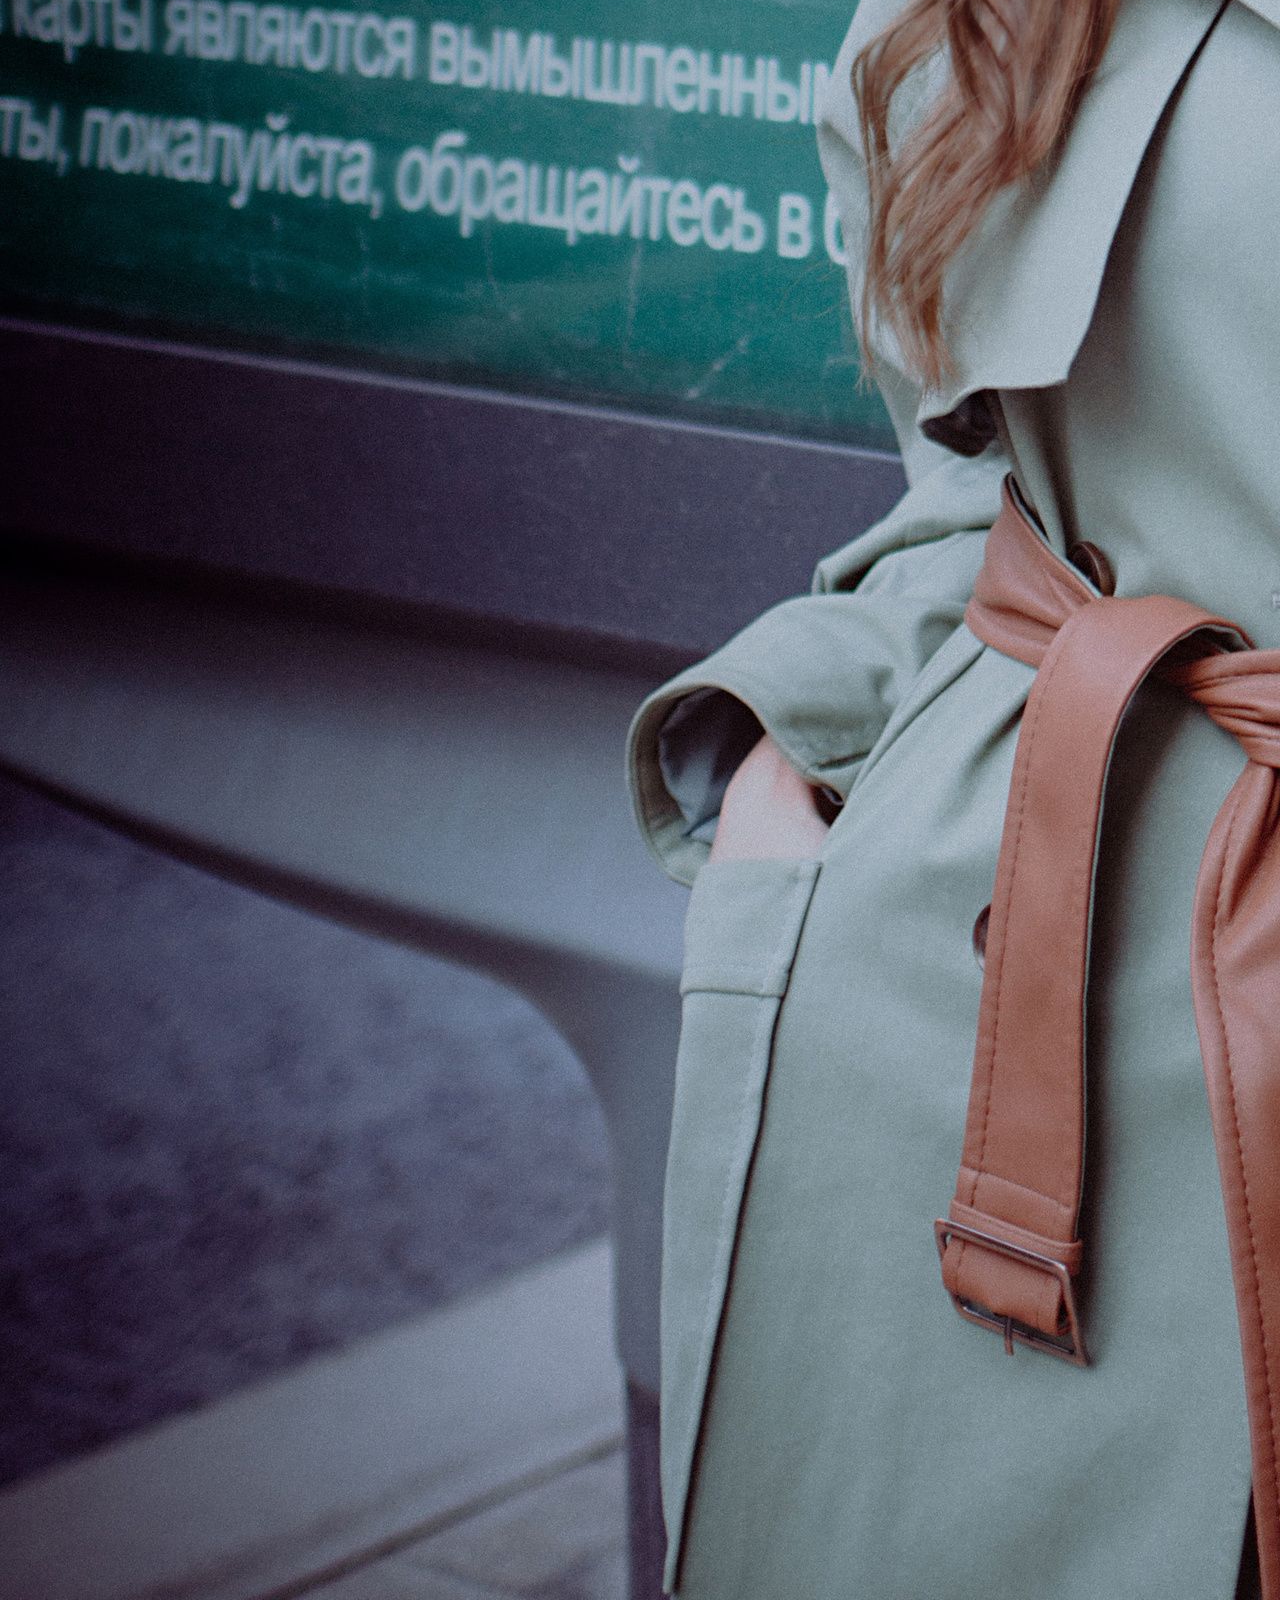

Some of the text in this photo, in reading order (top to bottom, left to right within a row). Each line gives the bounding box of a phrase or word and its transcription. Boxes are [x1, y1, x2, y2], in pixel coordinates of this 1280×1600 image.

[78, 108, 383, 218] пожалуйста,
[396, 132, 766, 256] обращайтесь
[777, 192, 813, 259] в
